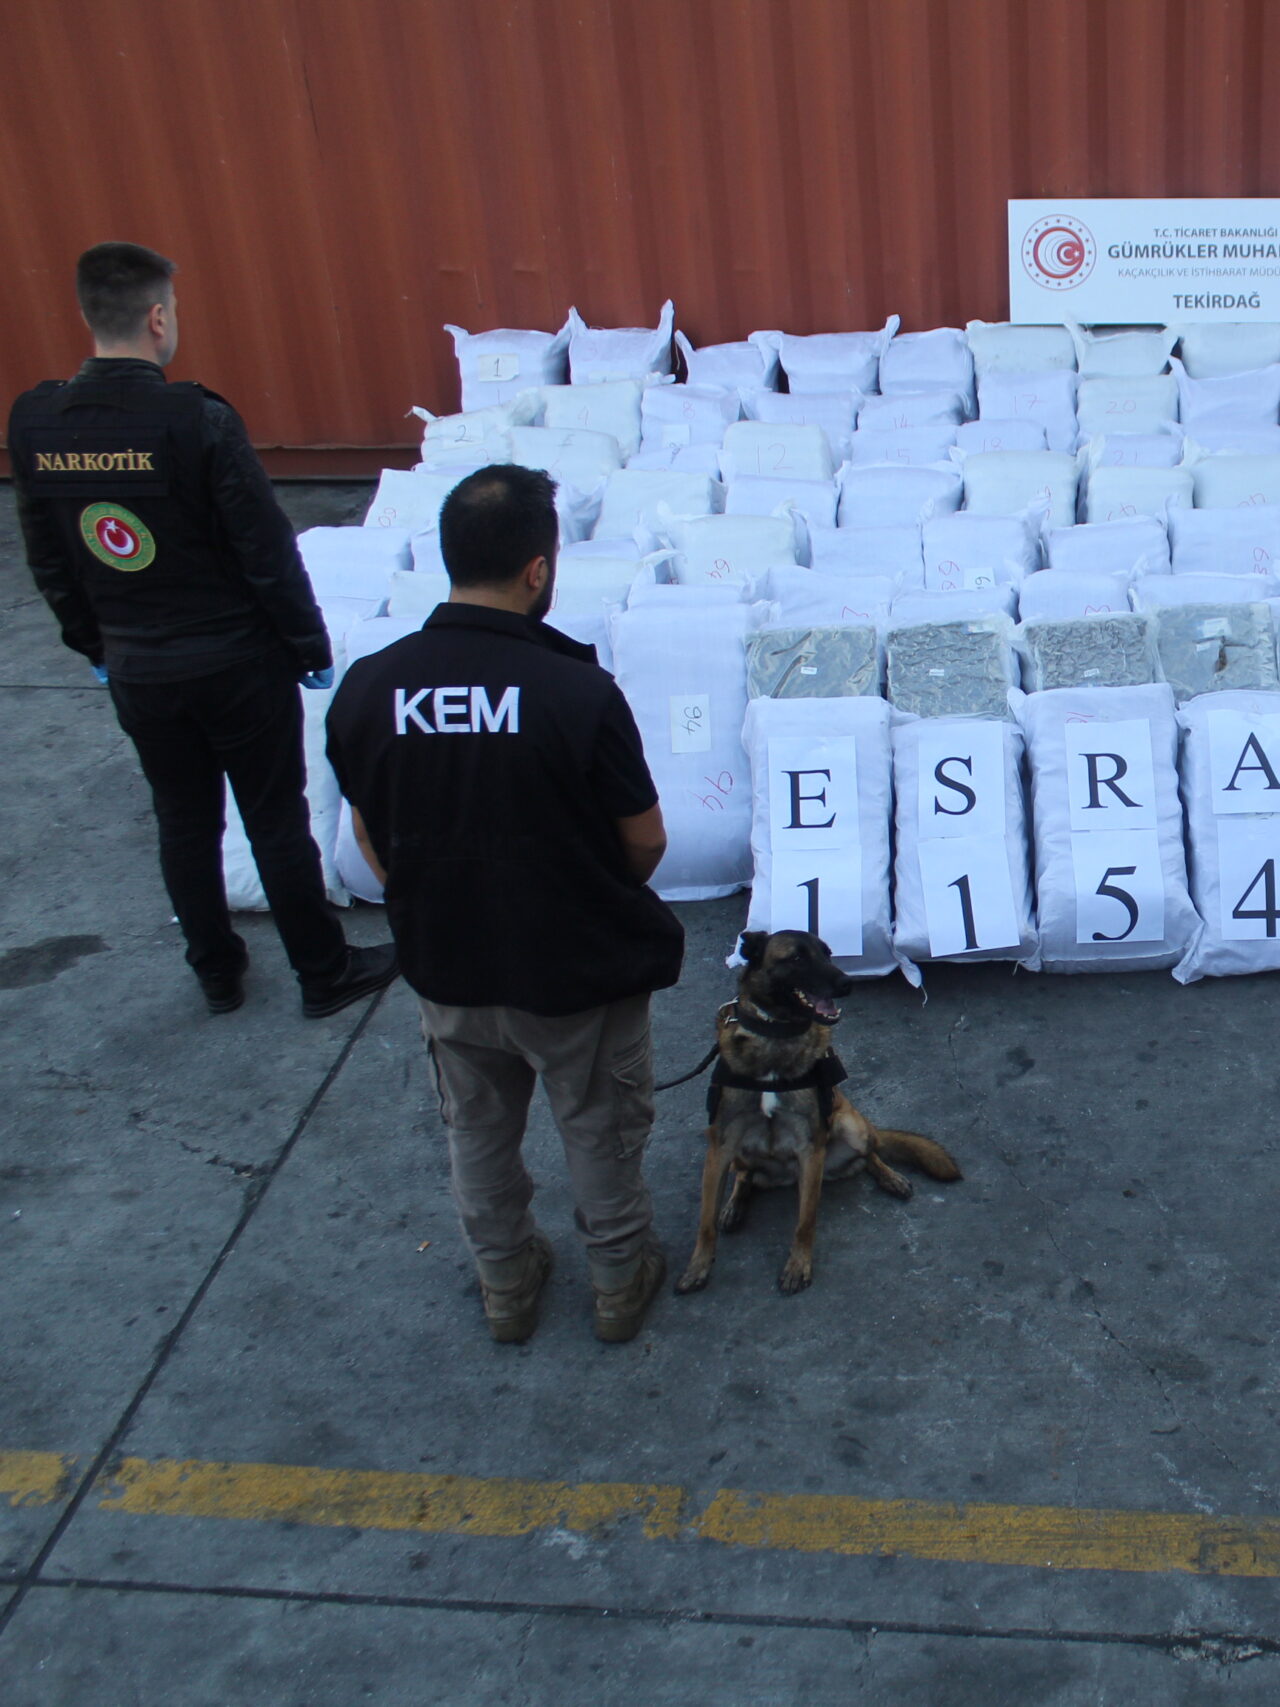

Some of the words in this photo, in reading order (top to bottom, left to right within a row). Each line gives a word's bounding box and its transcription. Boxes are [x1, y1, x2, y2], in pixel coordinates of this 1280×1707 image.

[1153, 228, 1172, 238] T.C.
[1175, 226, 1218, 238] TİCARET
[1220, 226, 1278, 238] BAKANLIĞI
[1107, 241, 1218, 259] GÜMRÜKLER
[1117, 267, 1175, 279] KAÇAKÇILIK
[1177, 267, 1188, 277] VE
[1191, 265, 1247, 277] İSTİHBARAT
[1172, 291, 1261, 309] TEKİRDAĞ
[35, 448, 155, 471] NARKOTİK
[394, 686, 521, 735] KEM
